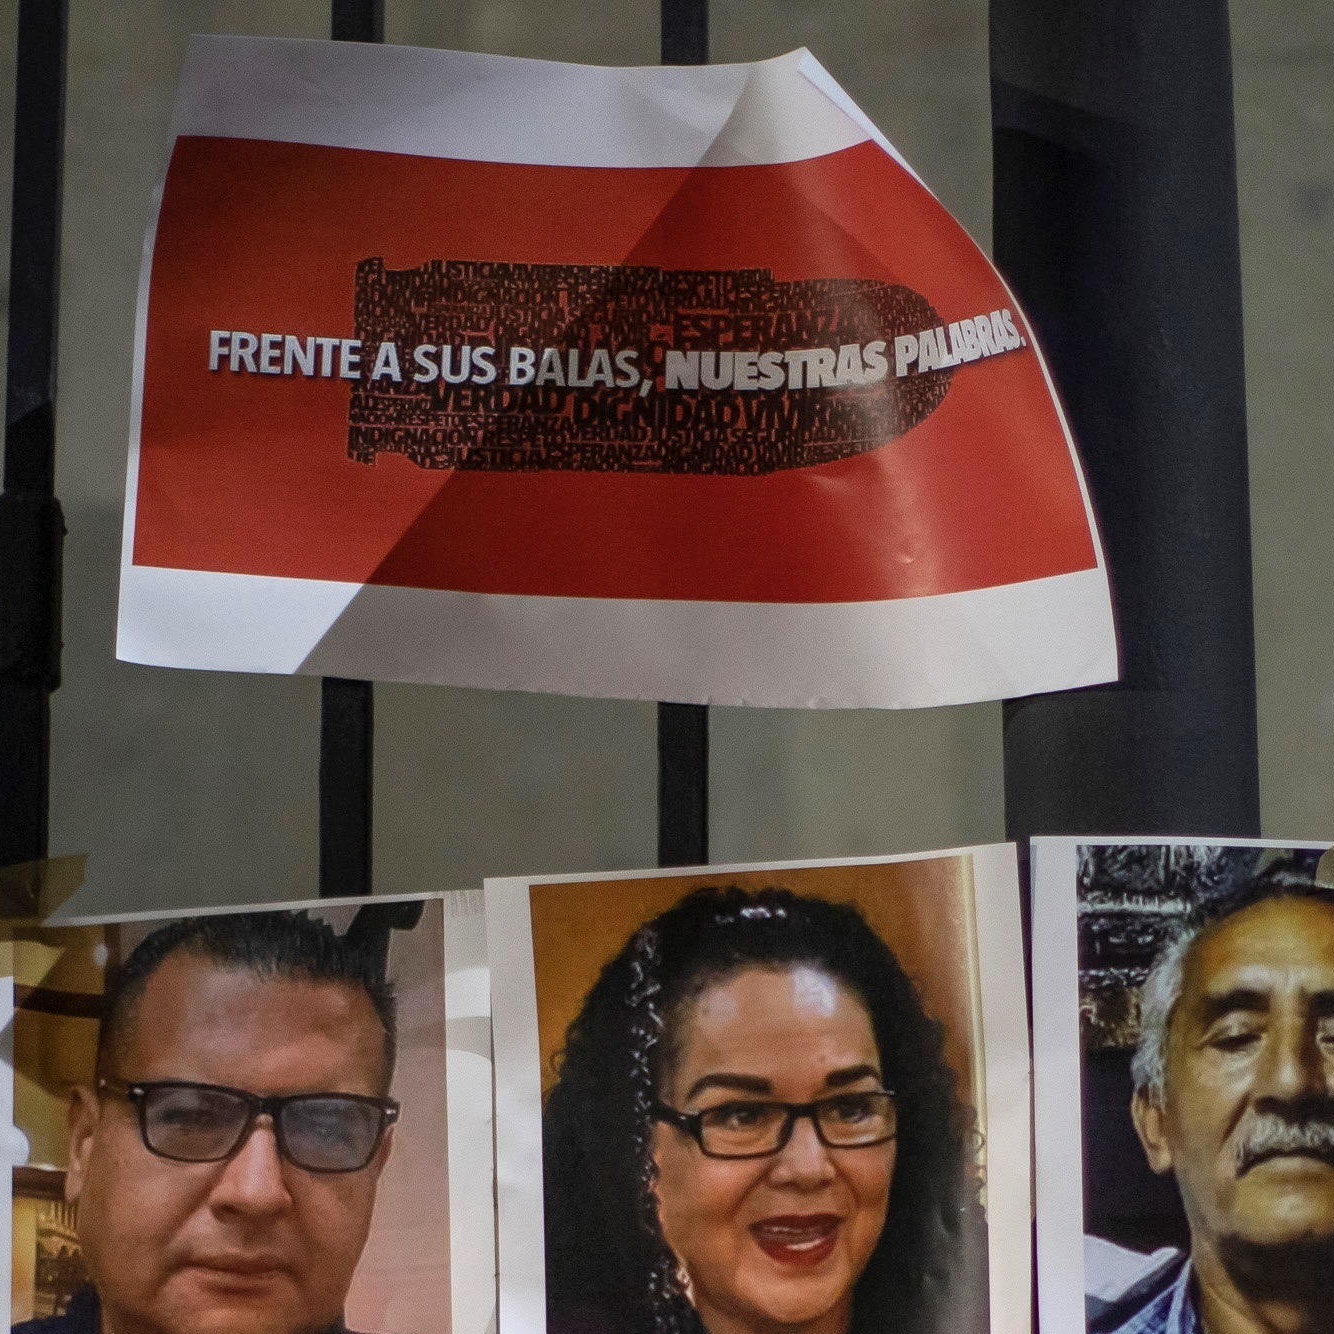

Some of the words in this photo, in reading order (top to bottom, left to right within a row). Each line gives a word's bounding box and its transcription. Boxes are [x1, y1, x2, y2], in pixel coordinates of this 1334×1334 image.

[208, 329, 363, 380] FRENTE
[370, 341, 404, 383] A
[413, 344, 497, 386] SUS
[508, 346, 654, 399] BALAS,
[664, 340, 889, 392] NUESTRAS
[894, 307, 1028, 378] PALABRAS.
